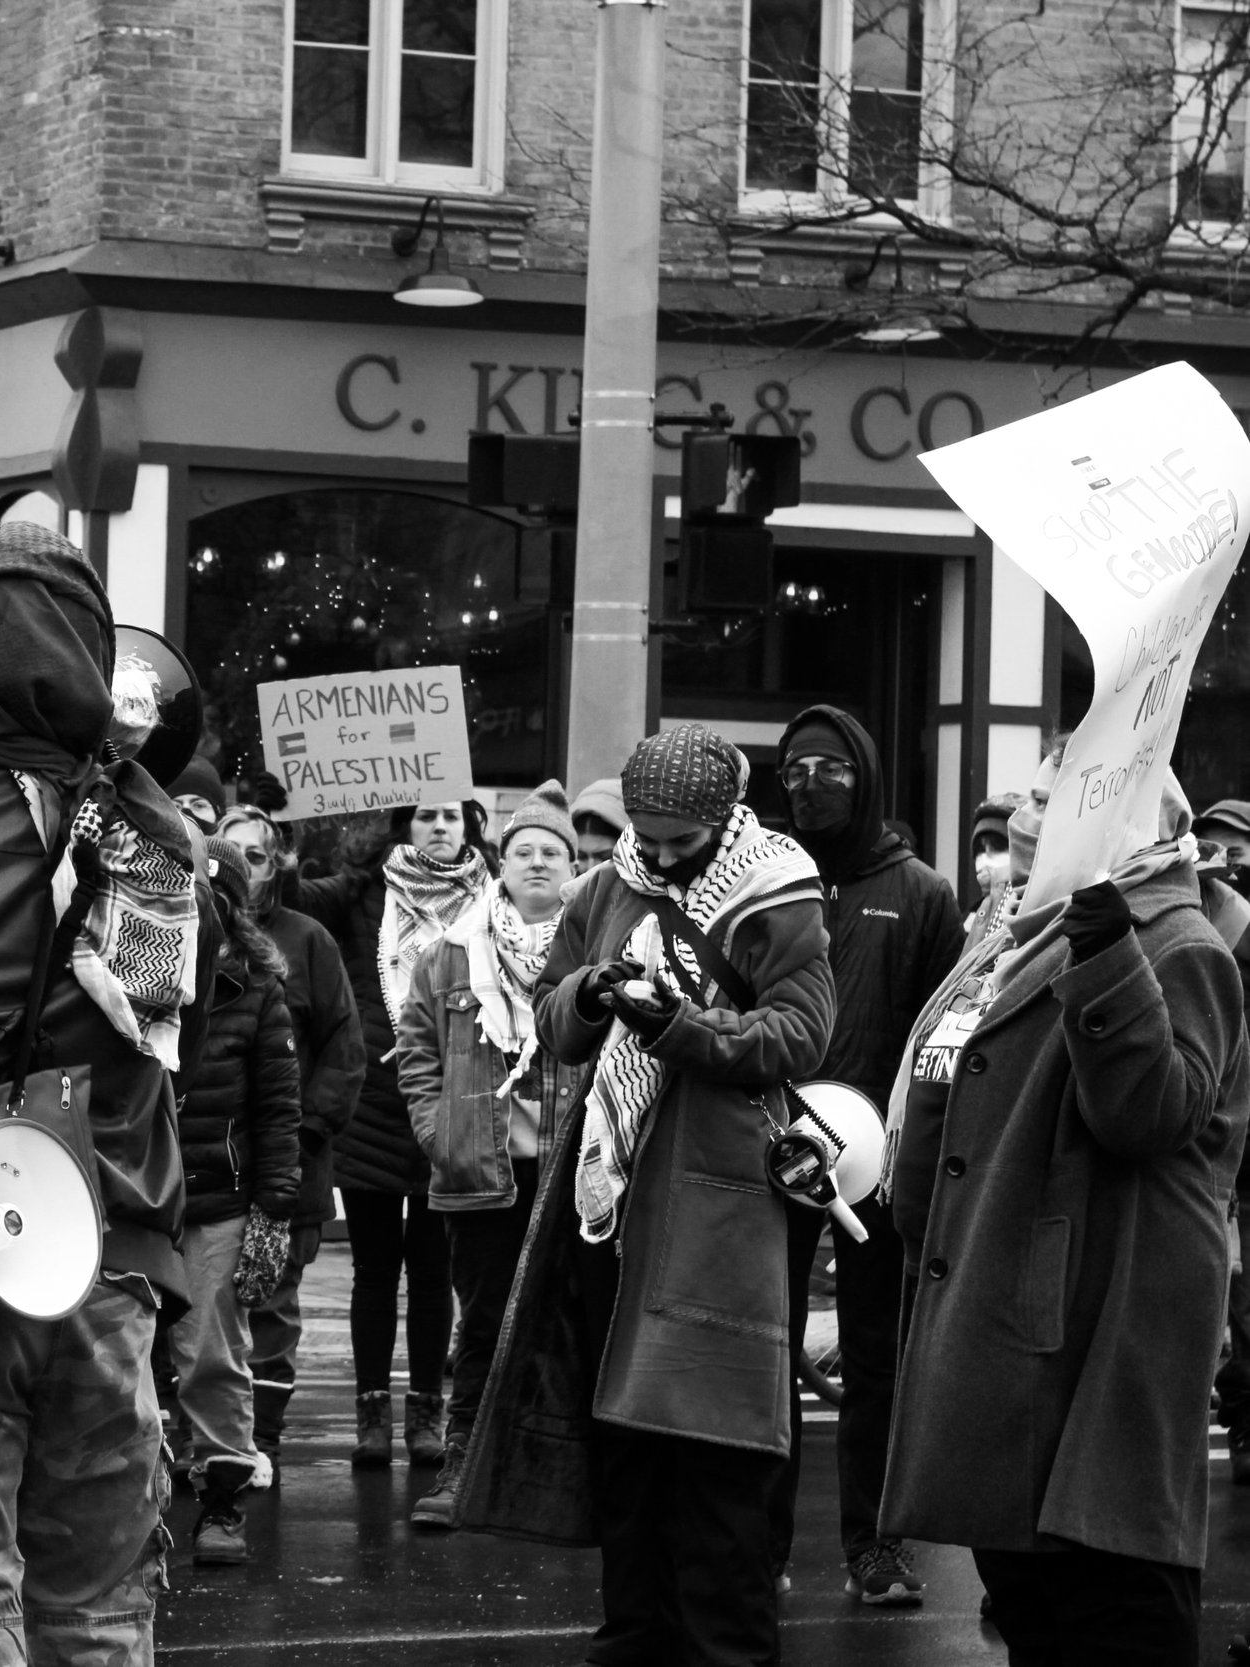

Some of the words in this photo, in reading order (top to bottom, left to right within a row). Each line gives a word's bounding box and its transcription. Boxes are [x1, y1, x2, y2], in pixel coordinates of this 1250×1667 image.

[1105, 447, 1219, 524] THE
[272, 681, 449, 728] ARMENIANS
[1133, 649, 1182, 731] NOT
[337, 726, 371, 745] for
[282, 752, 445, 793] PALESTINE
[870, 908, 899, 920] Columbia
